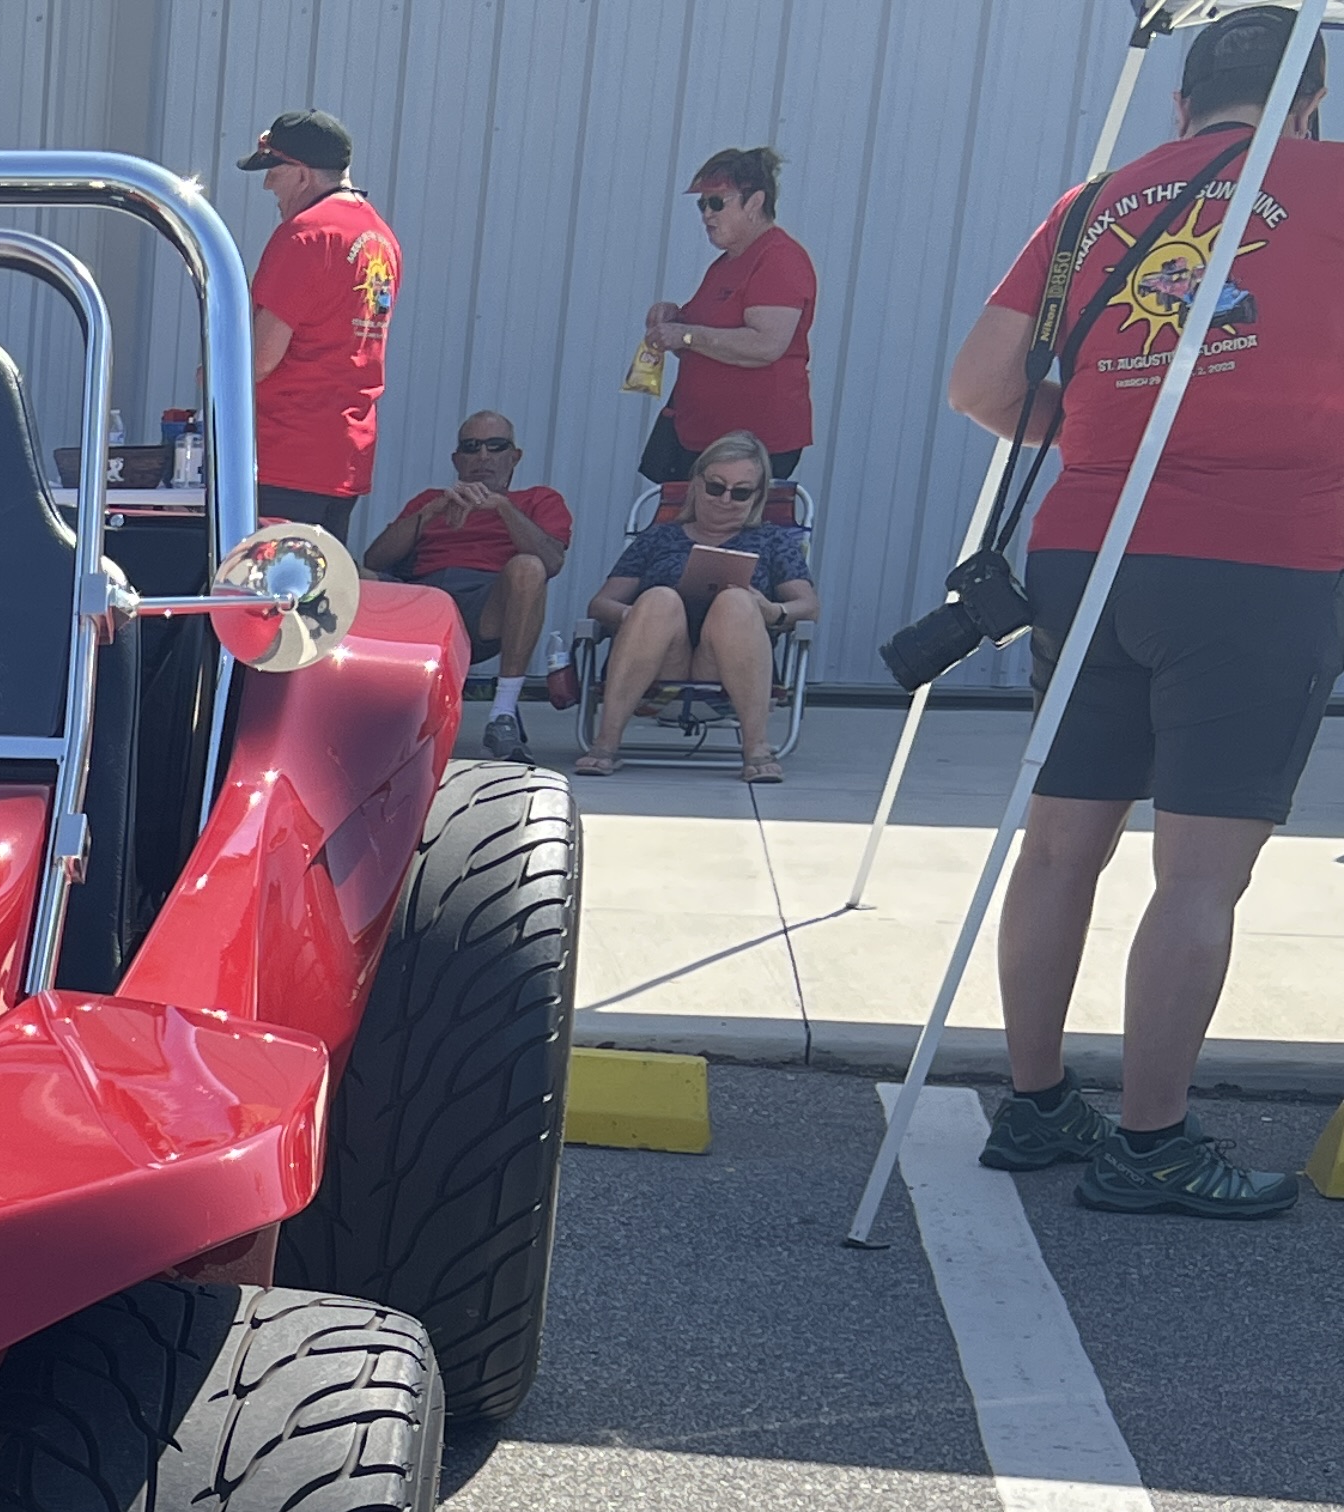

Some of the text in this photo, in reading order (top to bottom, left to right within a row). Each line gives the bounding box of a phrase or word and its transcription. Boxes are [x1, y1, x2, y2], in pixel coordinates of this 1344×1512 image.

[1114, 193, 1139, 217] IN
[1040, 251, 1072, 342] Nikon D850
[1199, 335, 1258, 356] LORIDA
